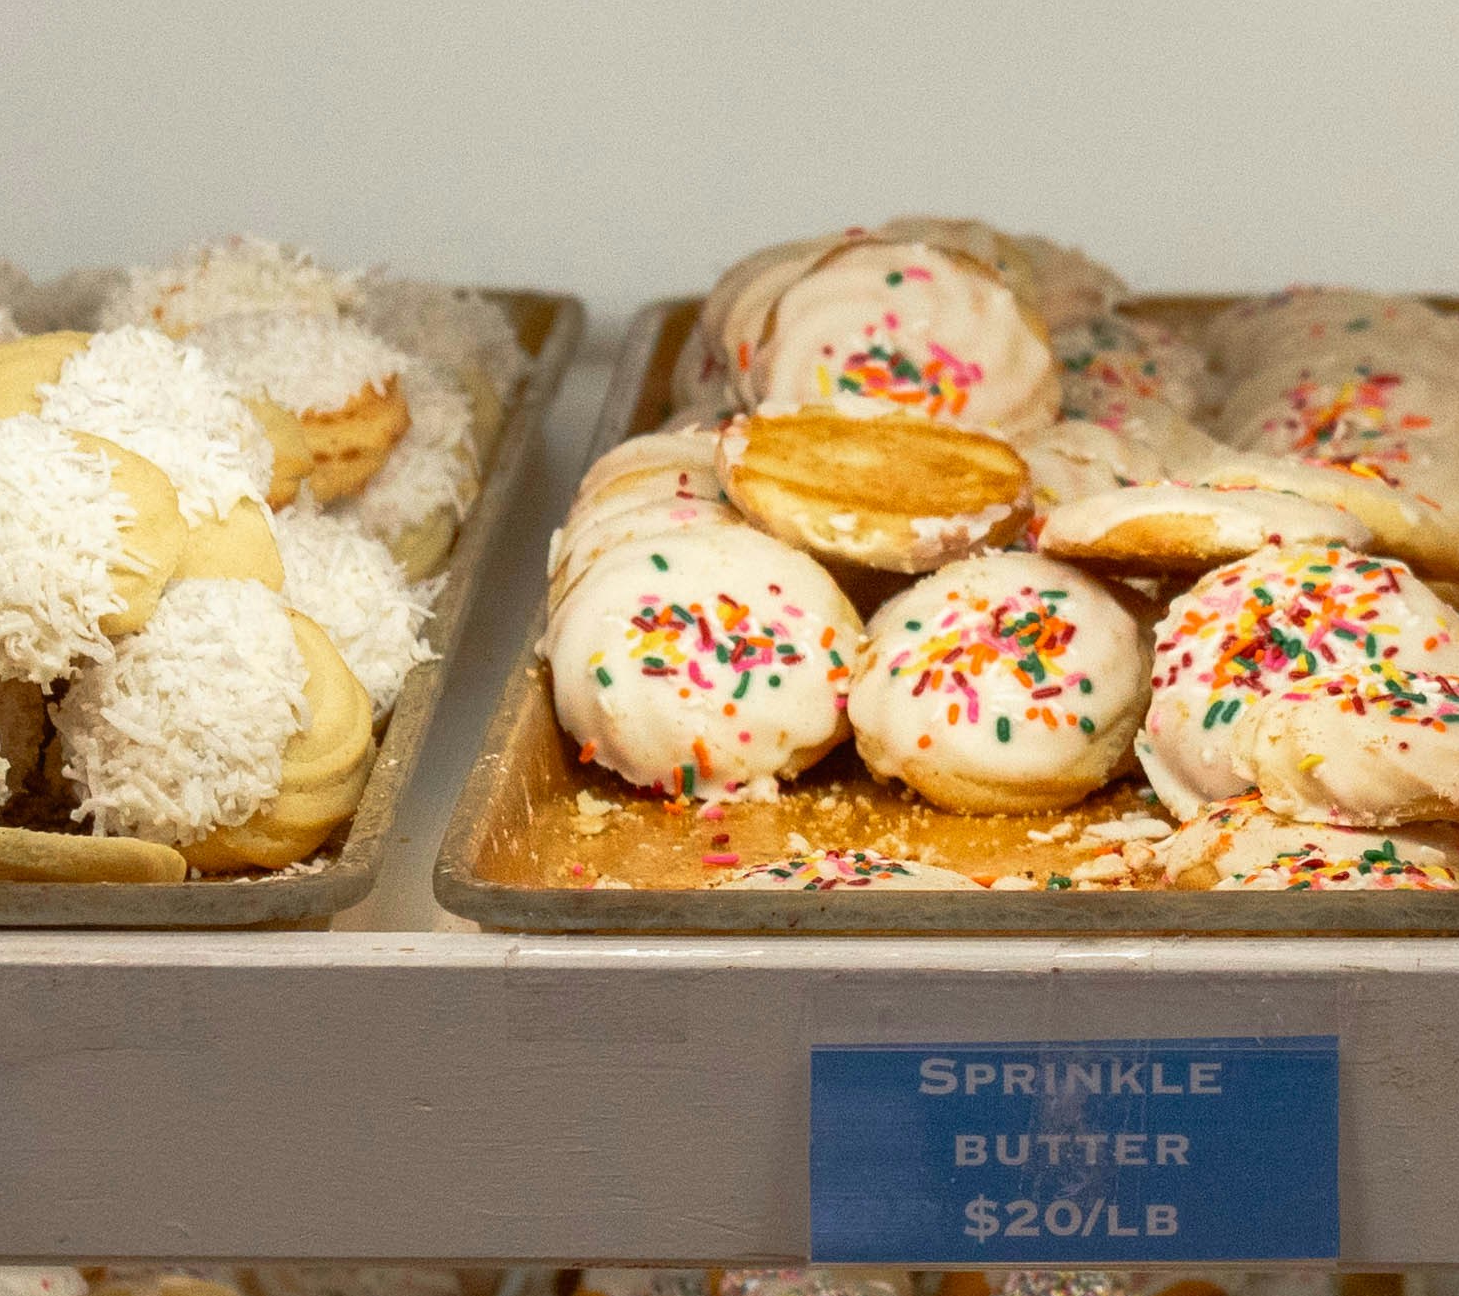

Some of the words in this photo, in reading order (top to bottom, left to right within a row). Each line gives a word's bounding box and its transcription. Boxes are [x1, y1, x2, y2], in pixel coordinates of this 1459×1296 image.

[919, 1057, 1222, 1095] SPRINKLE
[954, 1133, 1190, 1166] BUTTER
[964, 1194, 1179, 1243] $20/LB
